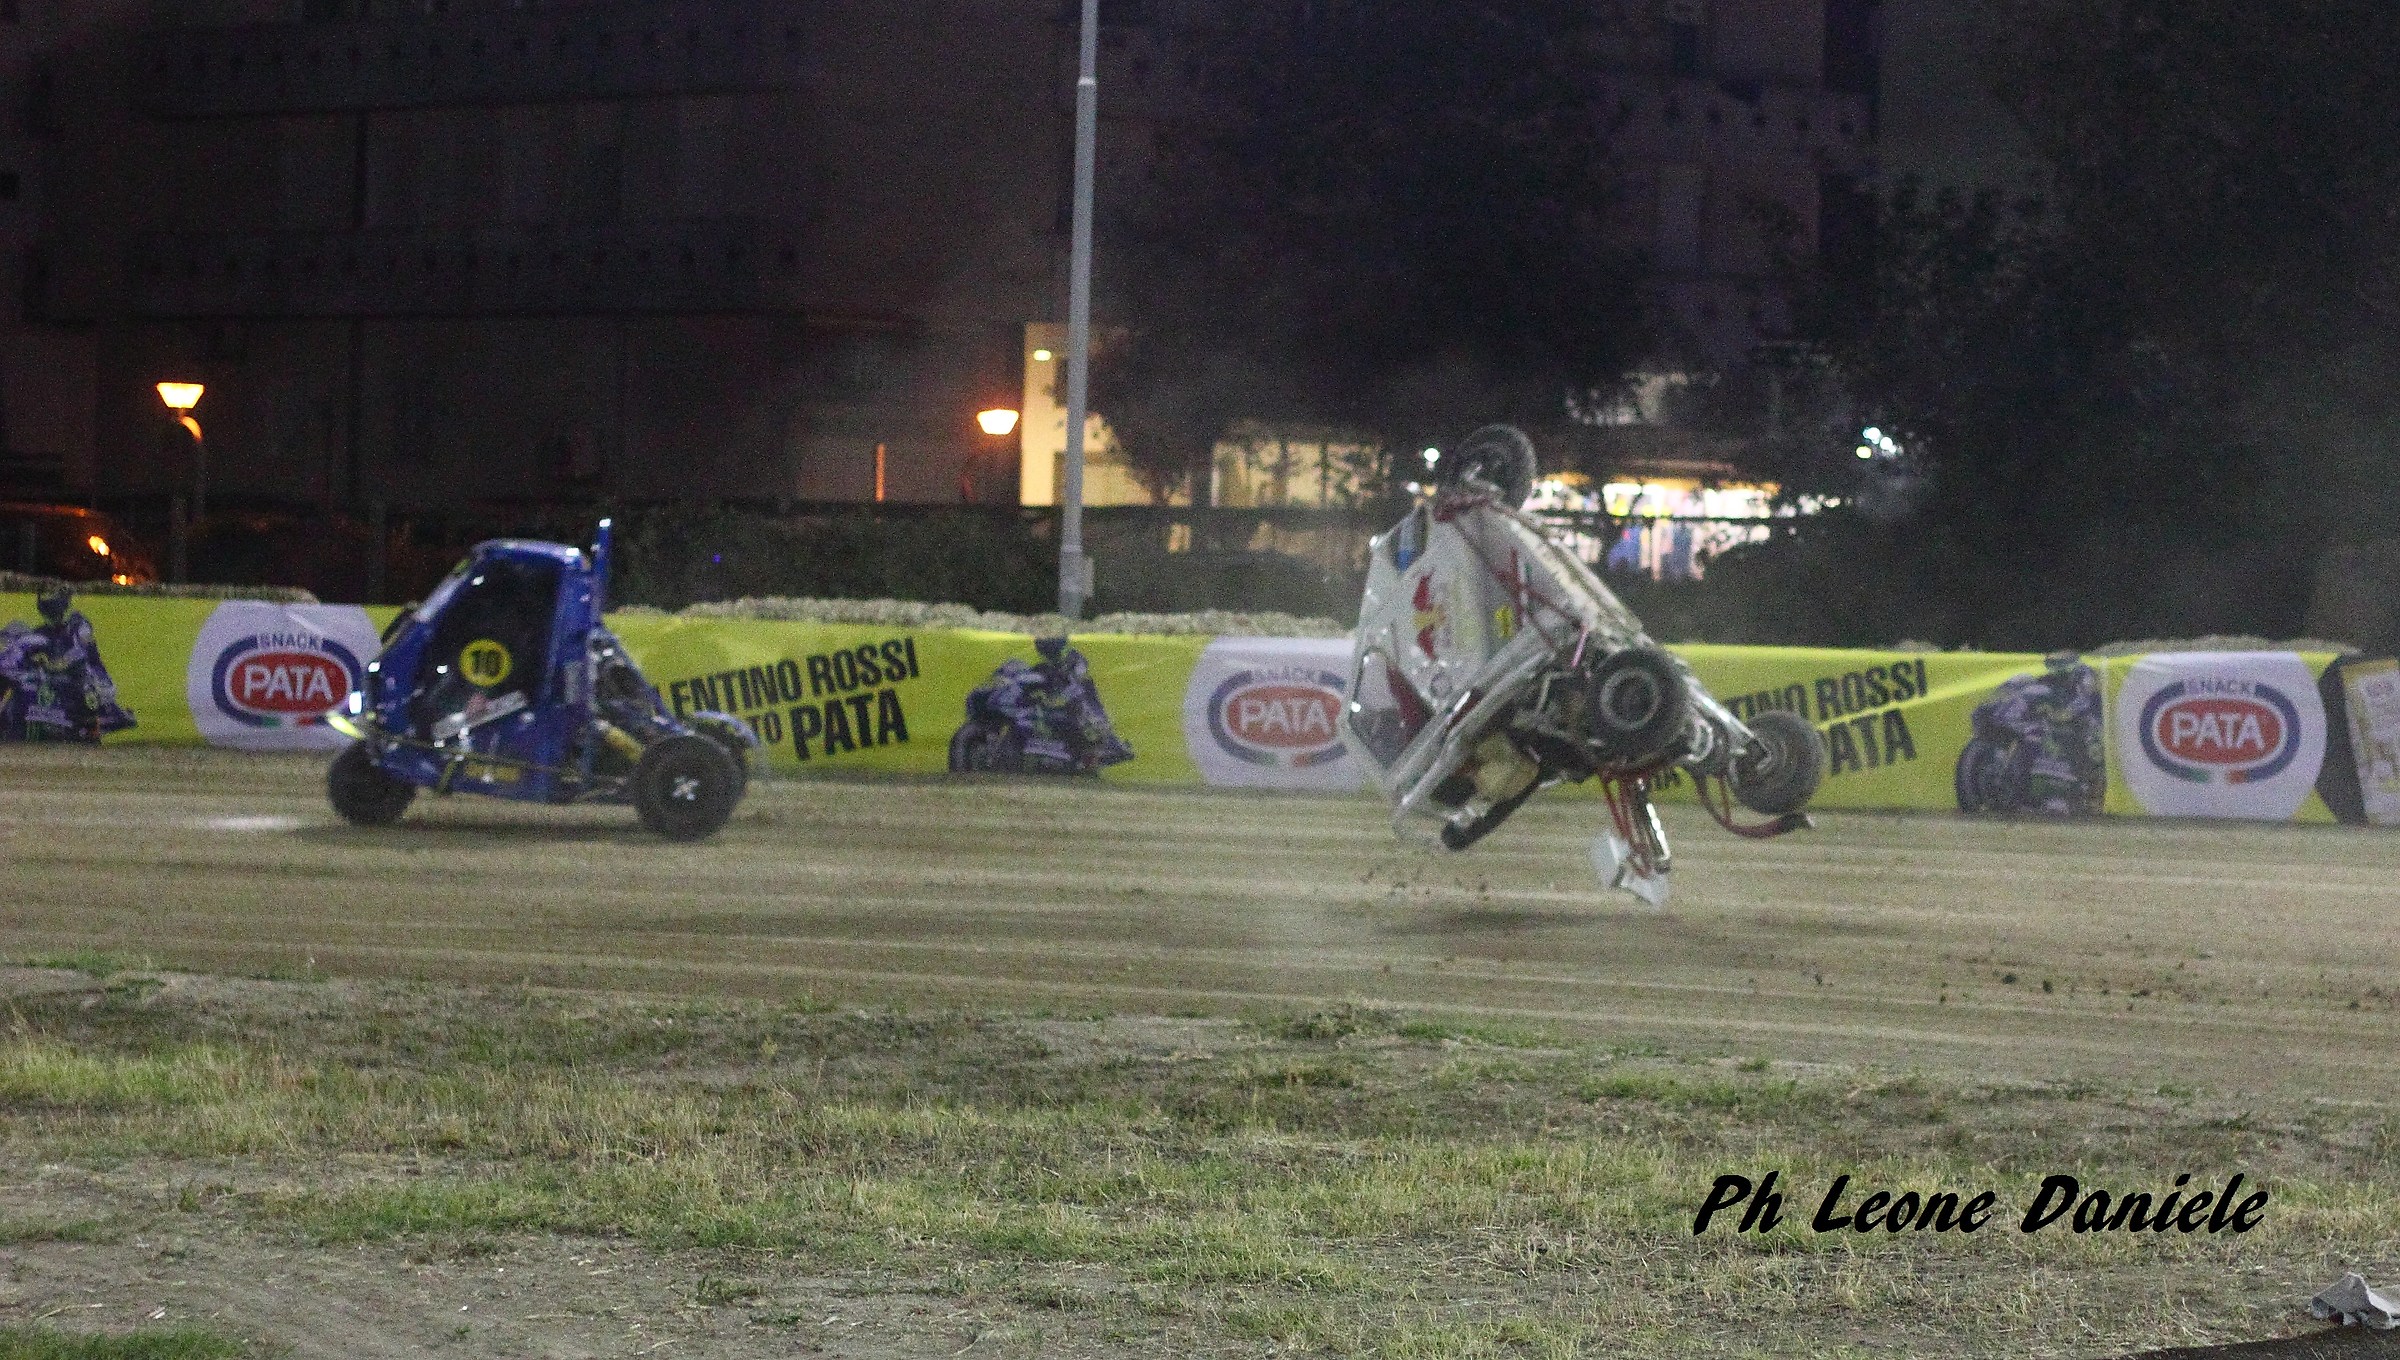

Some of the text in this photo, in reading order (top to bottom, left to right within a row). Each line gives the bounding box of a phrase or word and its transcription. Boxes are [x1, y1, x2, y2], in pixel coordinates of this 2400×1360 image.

[243, 664, 333, 701] PATA
[656, 635, 920, 720] ENTINO ROSSI
[1815, 658, 1927, 721] ROSSI
[746, 688, 910, 761] TO PATA
[1241, 698, 1332, 735] PATA
[1820, 708, 1918, 776] ATA
[2172, 711, 2265, 750] PATA
